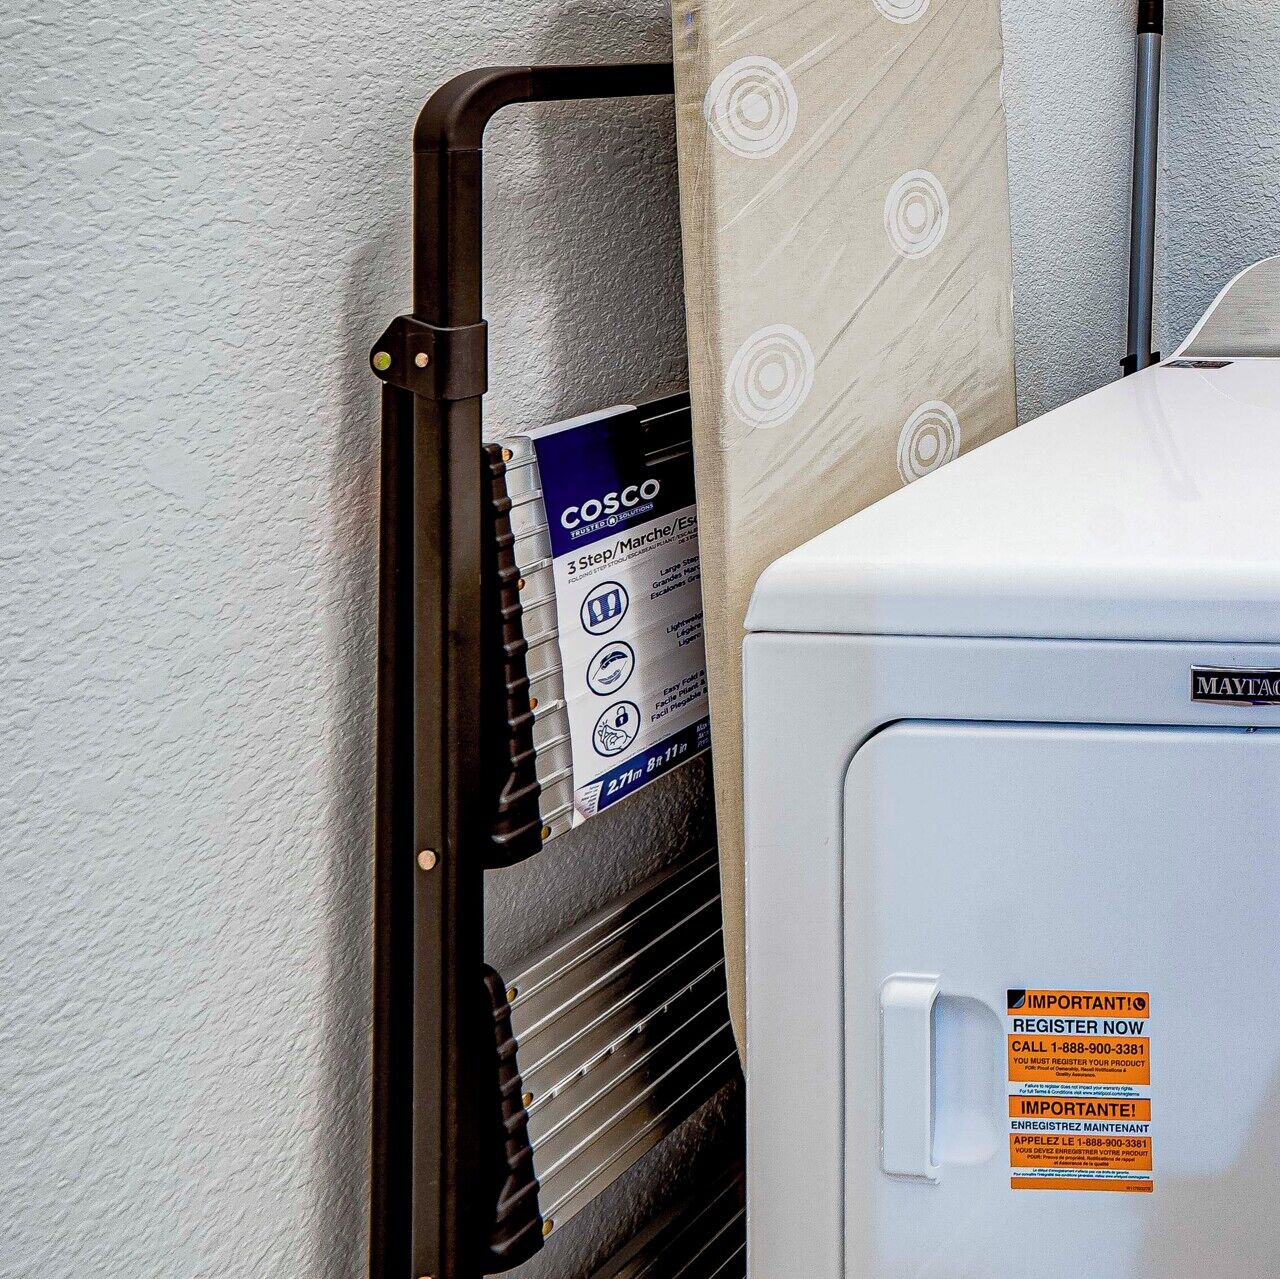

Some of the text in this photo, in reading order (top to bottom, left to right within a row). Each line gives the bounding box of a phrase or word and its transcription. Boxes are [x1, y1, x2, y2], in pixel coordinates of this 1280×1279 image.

[561, 479, 660, 529] COSCO
[571, 504, 654, 538] TRUSTED SOLUTIONS
[567, 561, 576, 575] 3
[568, 570, 593, 584] FOLDING
[594, 564, 607, 574] STEP
[660, 564, 680, 576] Large
[653, 573, 682, 588] Grandes
[651, 580, 686, 600] Escalones
[663, 683, 681, 695] Easy
[682, 674, 698, 686] Fold
[655, 694, 677, 709] Facile
[679, 684, 700, 698] Pliant
[651, 710, 669, 722] Facil
[671, 691, 701, 712] Plegable
[607, 769, 642, 796] 2.71m
[1028, 995, 1131, 1010] IMPORTANT!
[1013, 1018, 1144, 1035] REGISTER NOW
[1012, 1041, 1144, 1055] CALL 1-888-900-3381
[1021, 1101, 1136, 1117] IMPORTANTE!
[1011, 1121, 1149, 1133] ENREGISTREZ MAINTENANT
[1014, 1136, 1147, 1148] APPELEZ LE 1-888-900-3381
